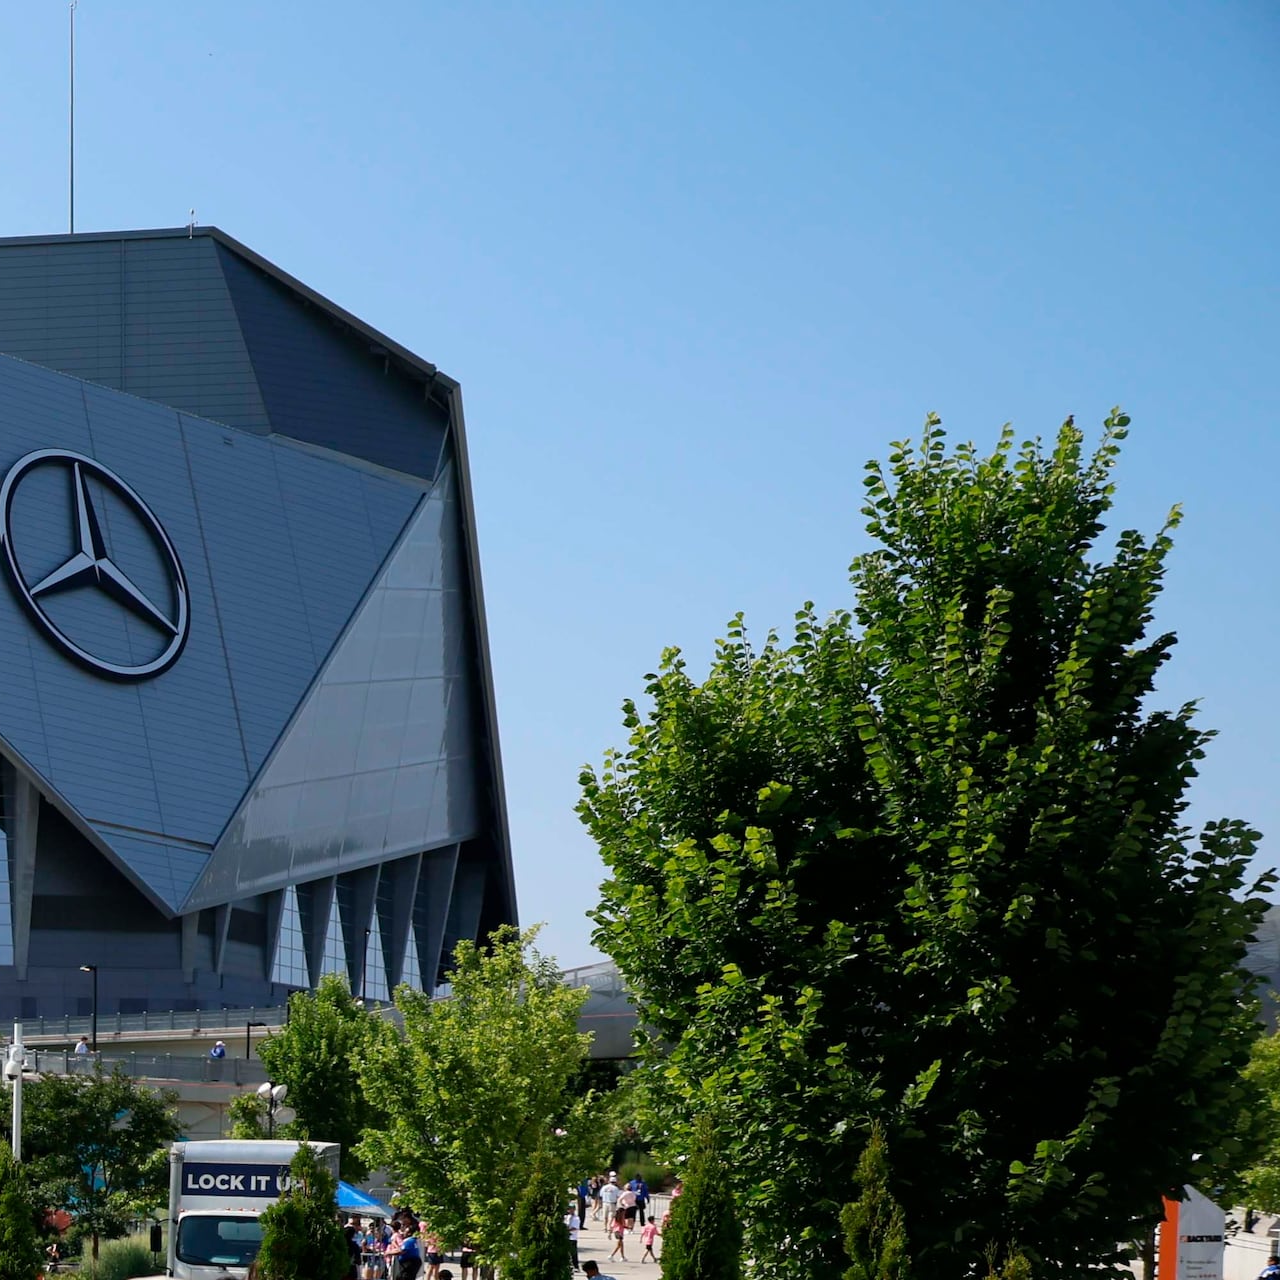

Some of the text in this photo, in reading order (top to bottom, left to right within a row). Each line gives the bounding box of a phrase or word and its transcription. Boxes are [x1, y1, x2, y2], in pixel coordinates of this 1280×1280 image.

[187, 1173, 302, 1192] LOCK IT U
